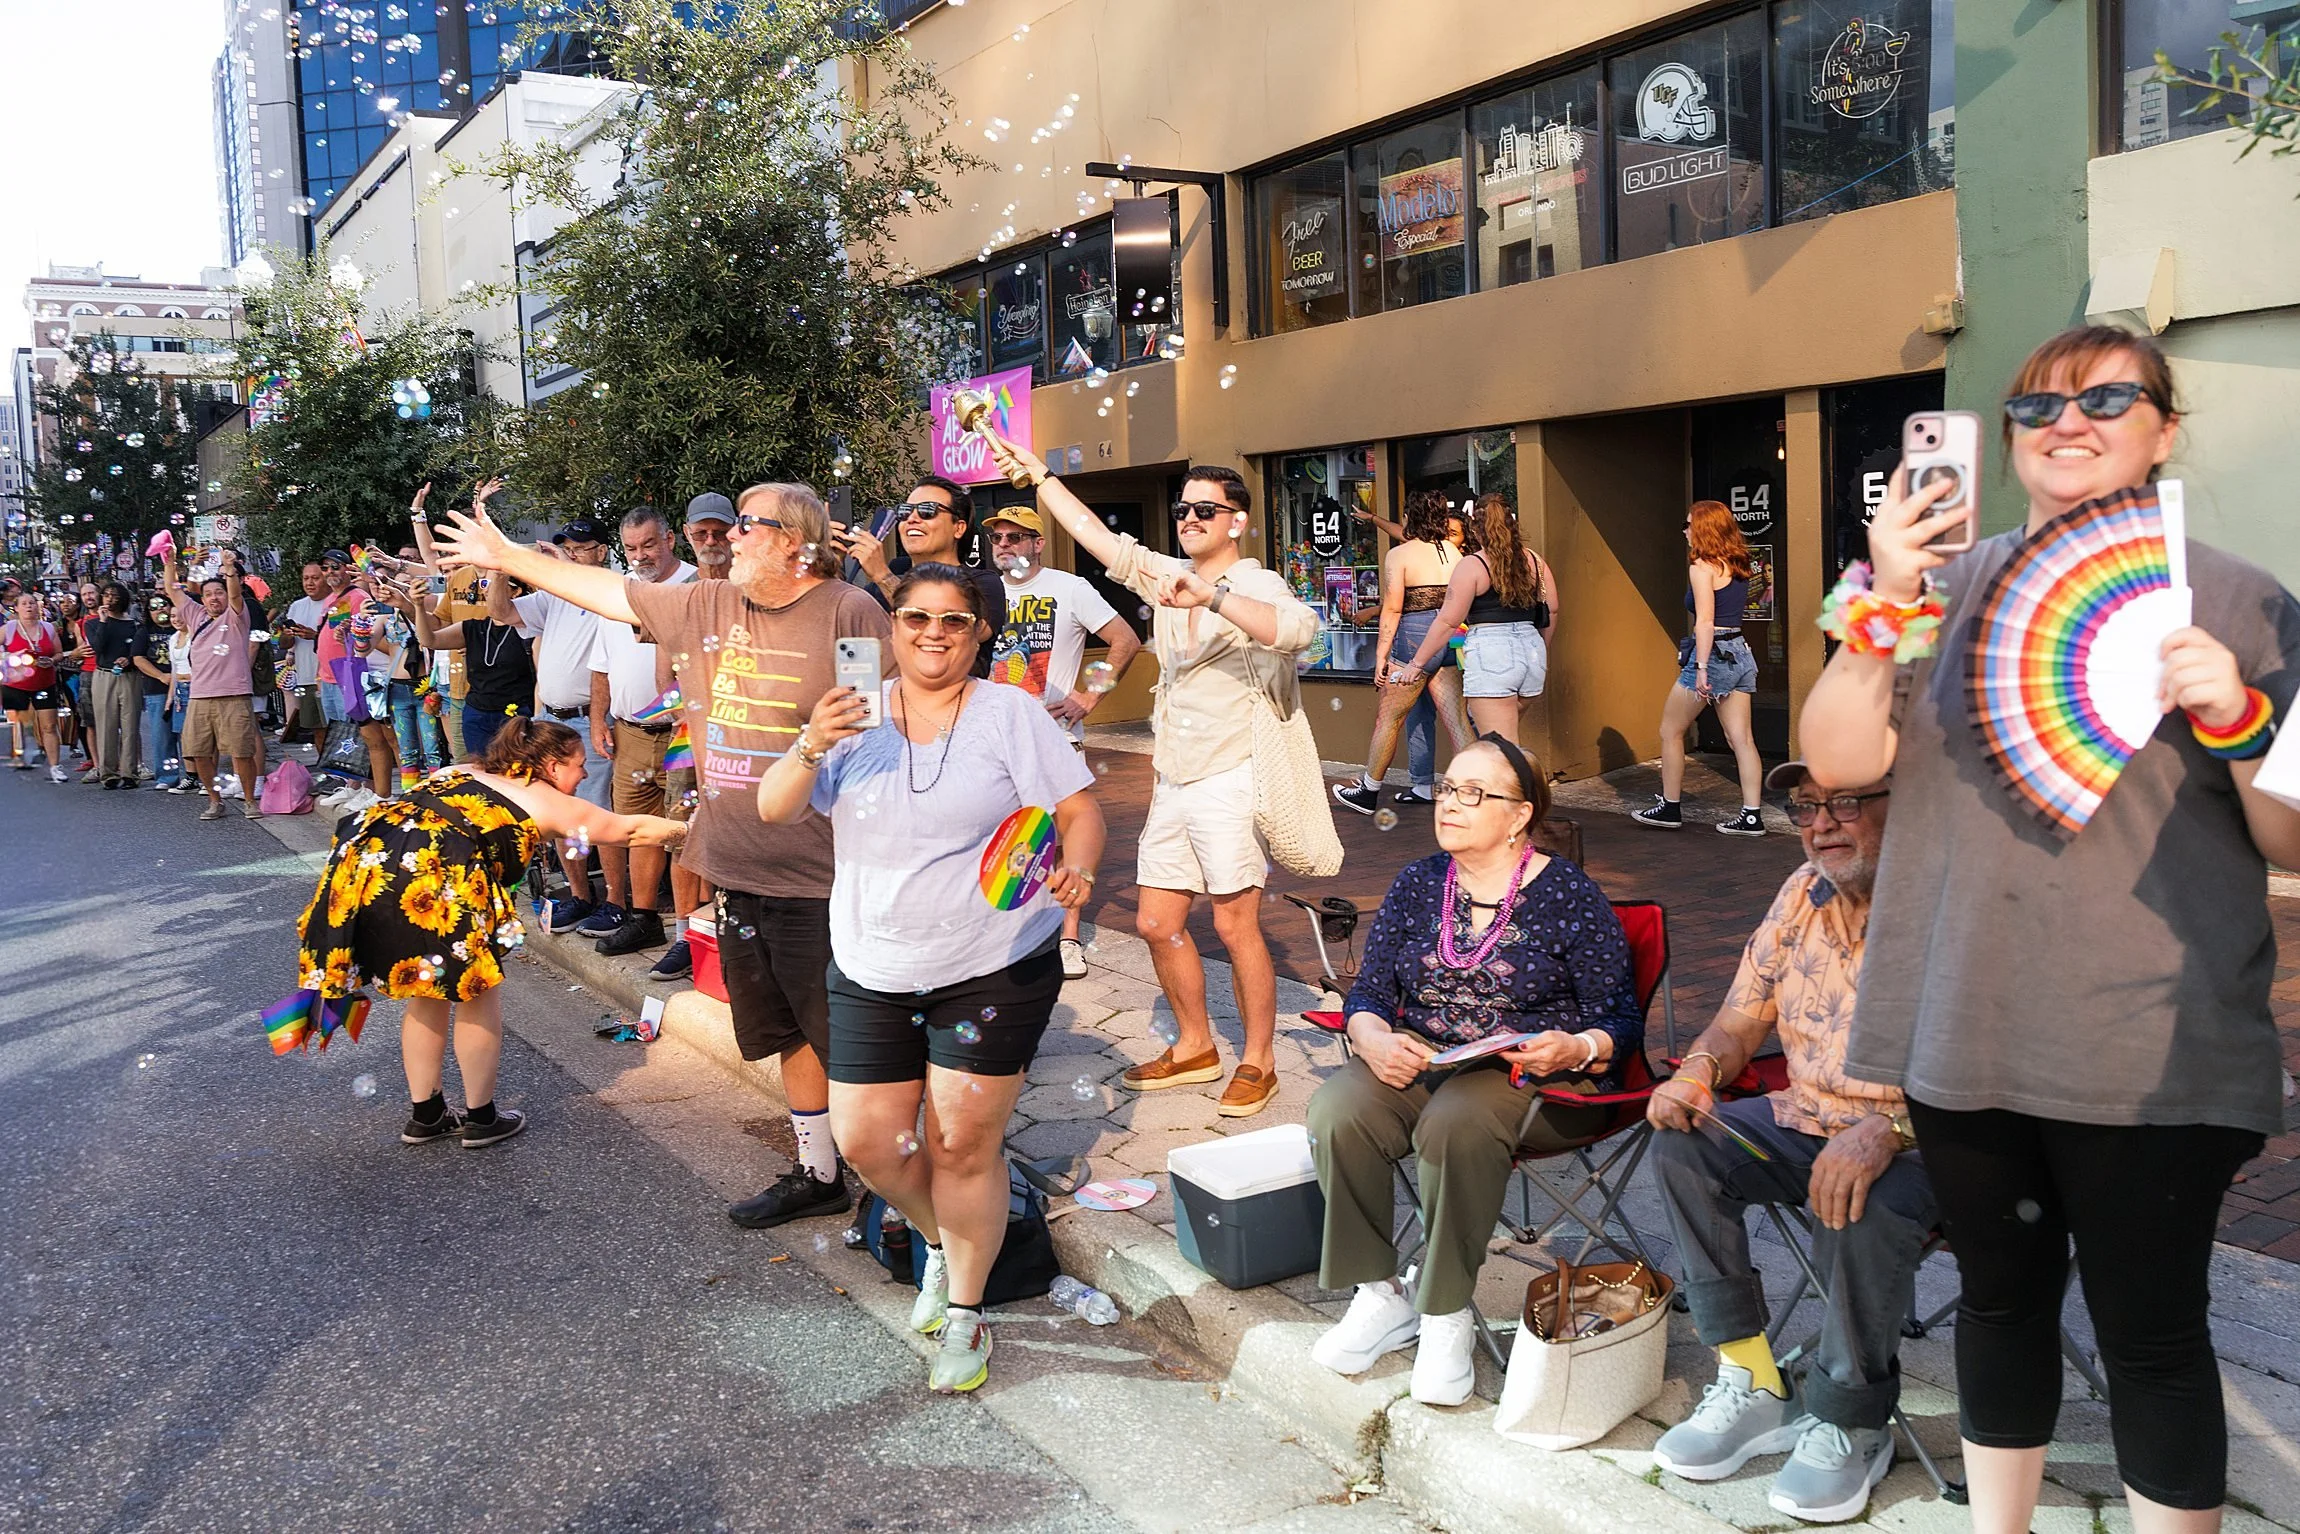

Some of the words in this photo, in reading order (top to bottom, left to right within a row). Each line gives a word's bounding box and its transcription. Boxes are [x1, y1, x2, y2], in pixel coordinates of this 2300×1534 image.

[1827, 56, 1848, 78] It's
[1650, 82, 1679, 109] UCF
[1810, 75, 1892, 105] Somewhere
[1627, 165, 1668, 190] BUD
[1670, 151, 1725, 180] LIGHT
[1377, 181, 1457, 233] Modelo
[1393, 225, 1440, 250] Especial
[1292, 250, 1324, 272] BEER
[1281, 270, 1335, 292] TOMORROW
[942, 440, 988, 475] GLOW
[1098, 442, 1113, 459] 64
[1730, 484, 1770, 512] 64
[1863, 471, 1888, 504] 6
[1313, 511, 1340, 536] 64
[1733, 511, 1770, 521] NORTH
[1314, 535, 1340, 544] NORTH
[727, 623, 752, 644] Be
[1035, 622, 1051, 632] THE
[1029, 640, 1052, 649] ROOM
[721, 648, 758, 673] Cool
[711, 672, 737, 694] Be
[706, 722, 725, 745] Be
[704, 749, 752, 776] Proud
